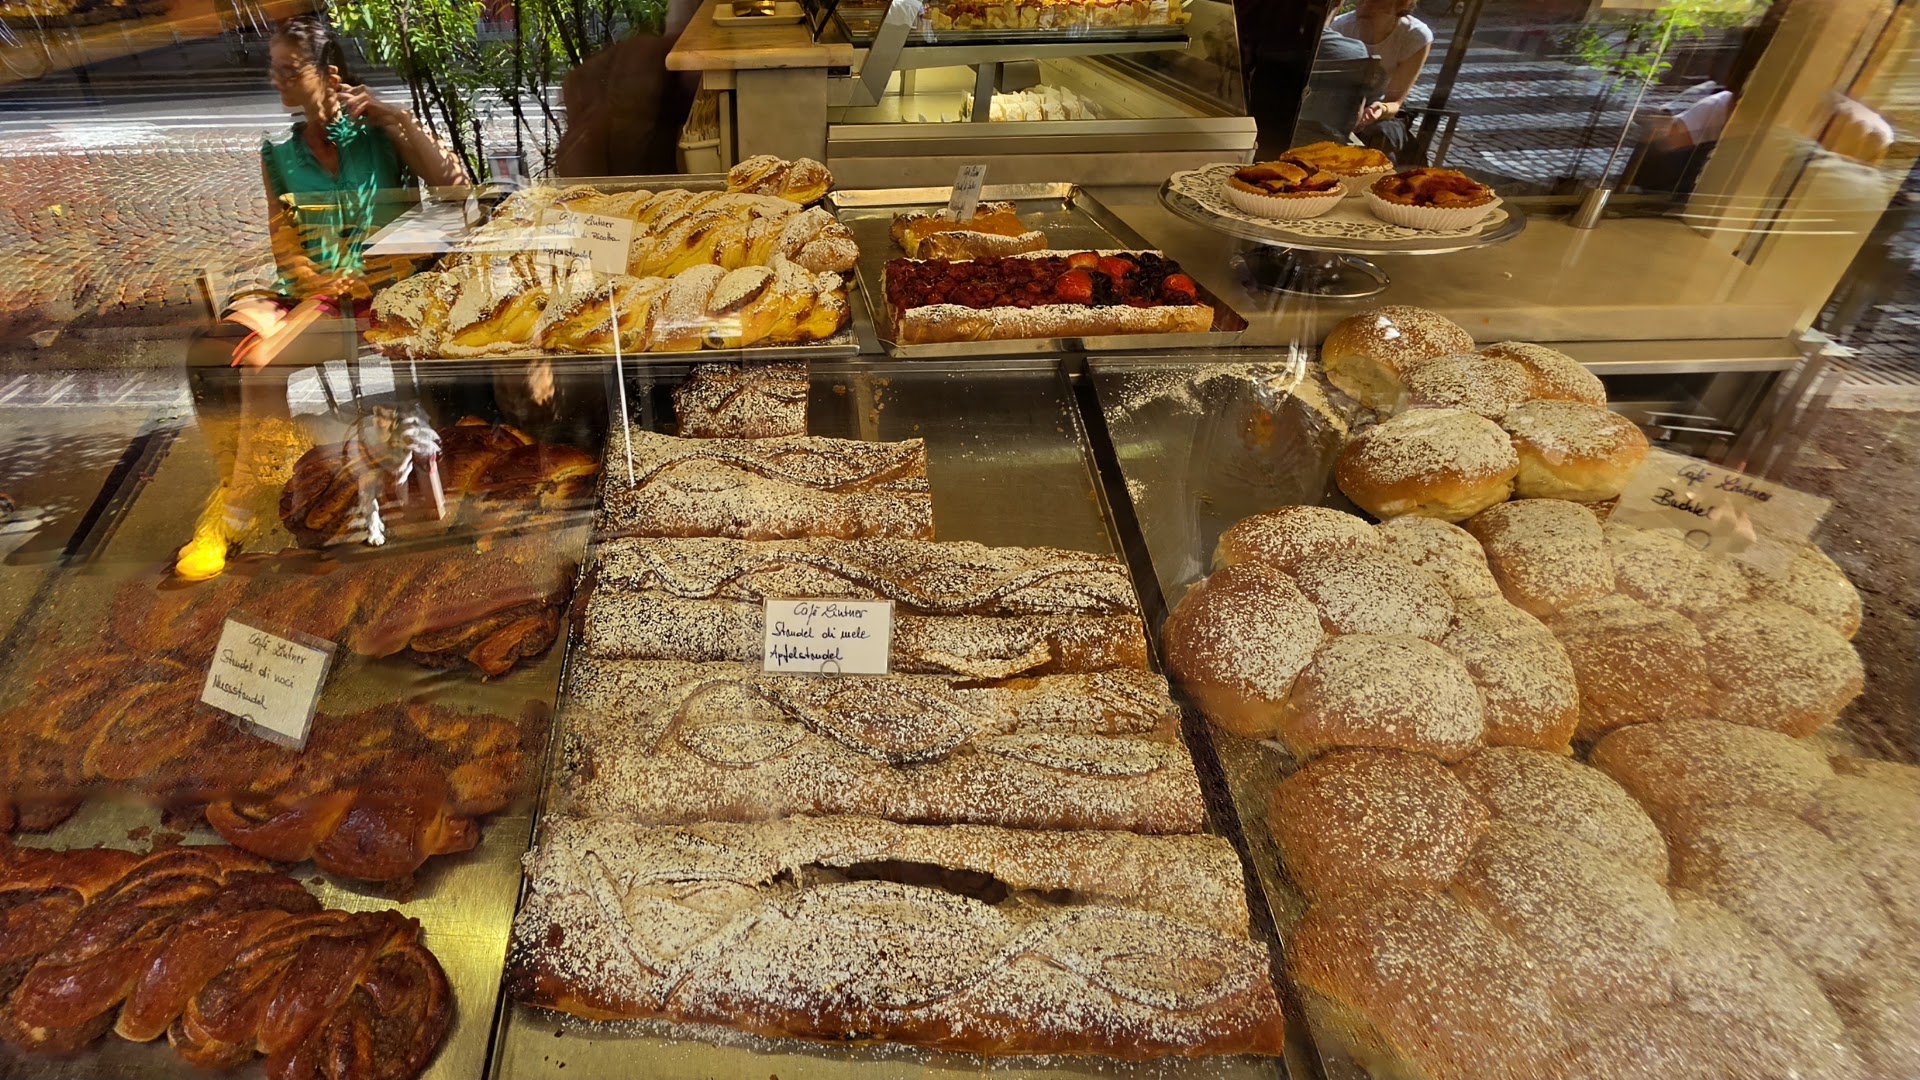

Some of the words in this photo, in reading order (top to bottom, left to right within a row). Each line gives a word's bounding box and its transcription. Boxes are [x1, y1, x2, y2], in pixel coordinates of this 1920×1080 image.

[581, 230, 588, 239] di
[821, 603, 868, 619] Lintner
[772, 621, 815, 639] Strudel
[822, 627, 836, 639] di
[840, 627, 871, 640] mele
[272, 643, 307, 665] Lintner
[769, 644, 844, 666] Apfelstrudel
[220, 648, 253, 673] Strudel
[258, 666, 271, 679] di
[274, 675, 295, 689] noci
